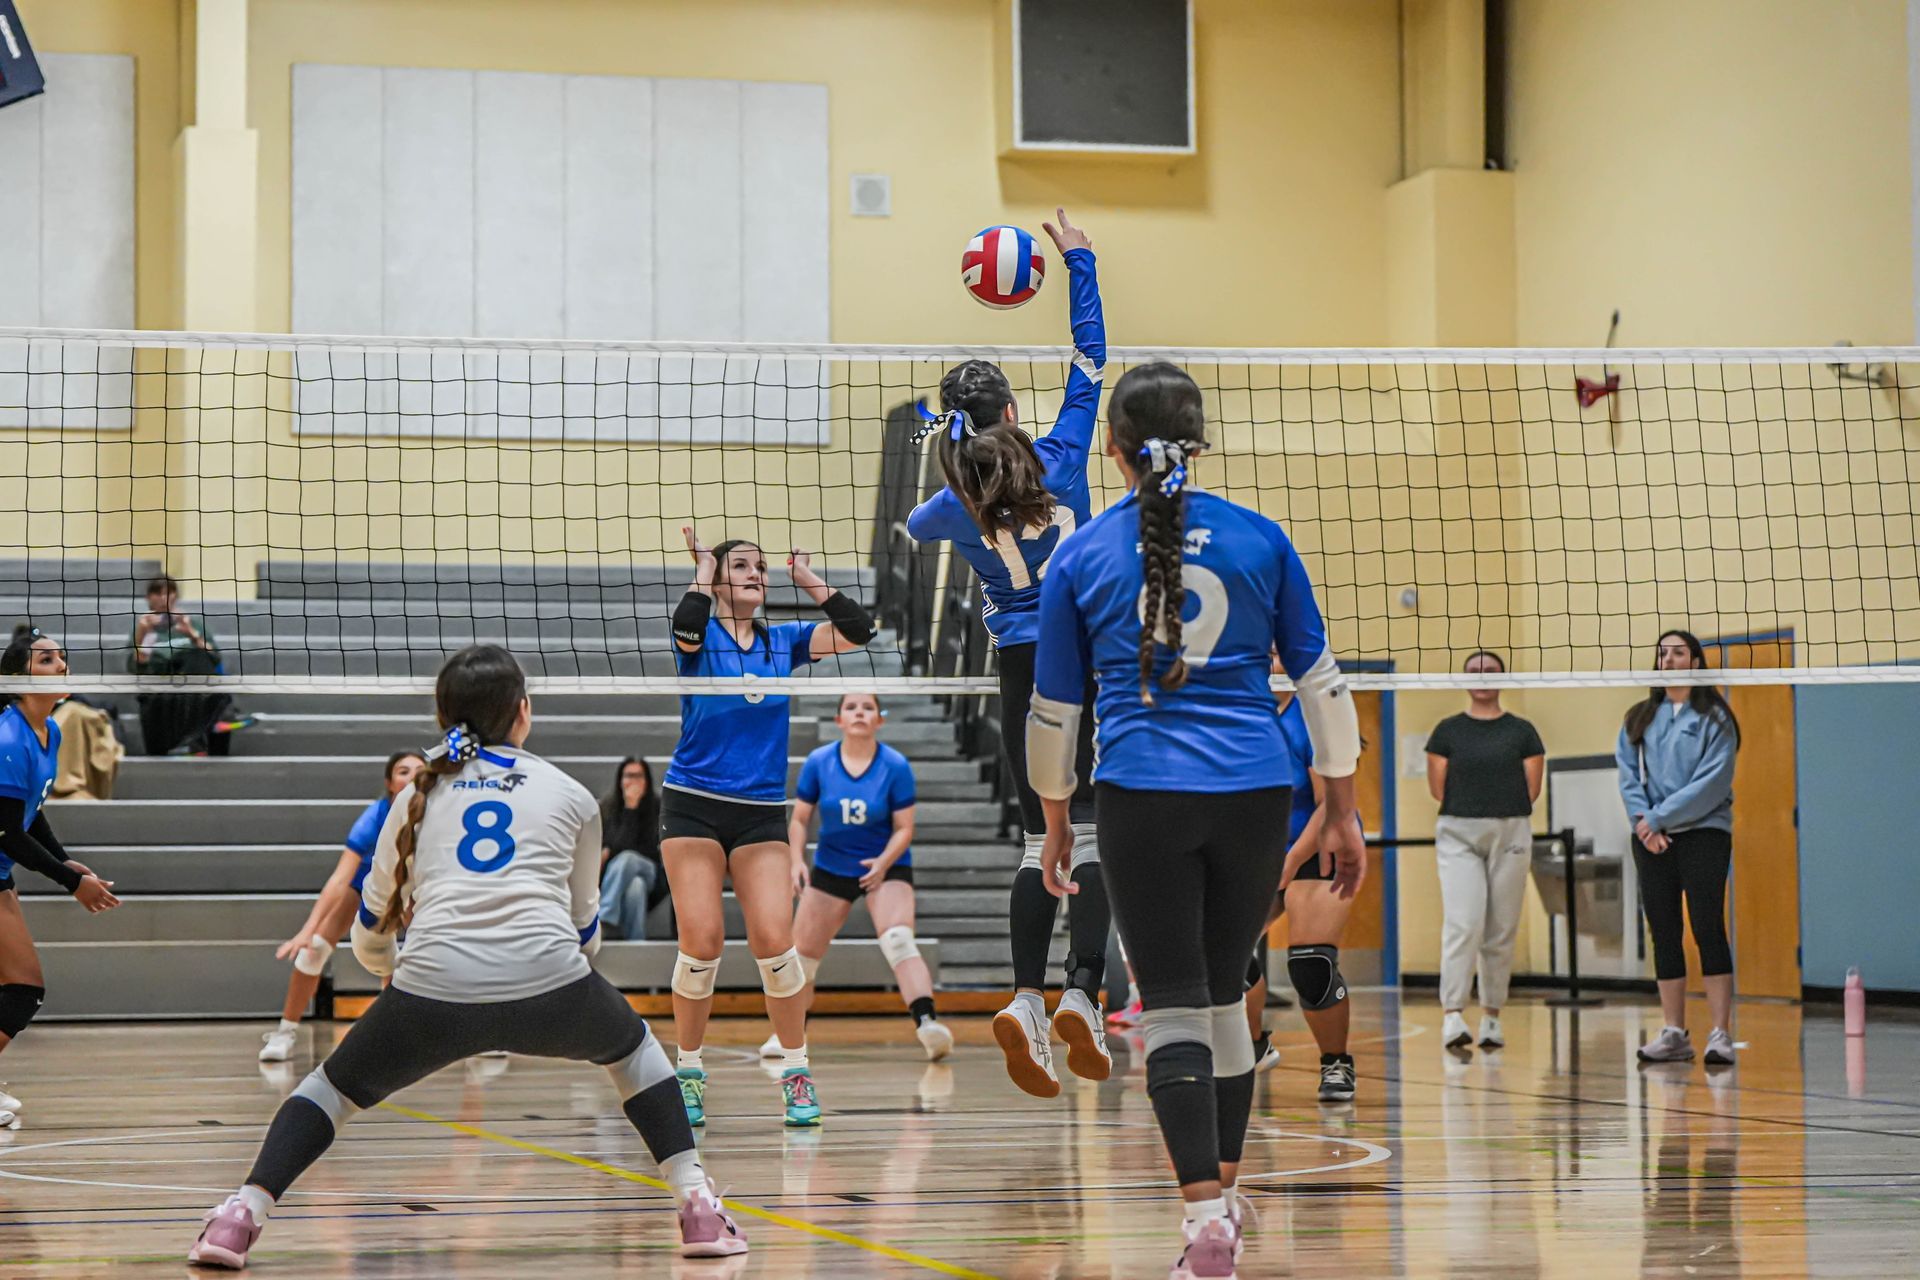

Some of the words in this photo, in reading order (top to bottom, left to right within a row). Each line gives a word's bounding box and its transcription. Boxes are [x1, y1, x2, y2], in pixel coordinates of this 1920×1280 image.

[1137, 563, 1229, 668] 9
[456, 800, 516, 874] 8
[839, 798, 867, 825] 13
